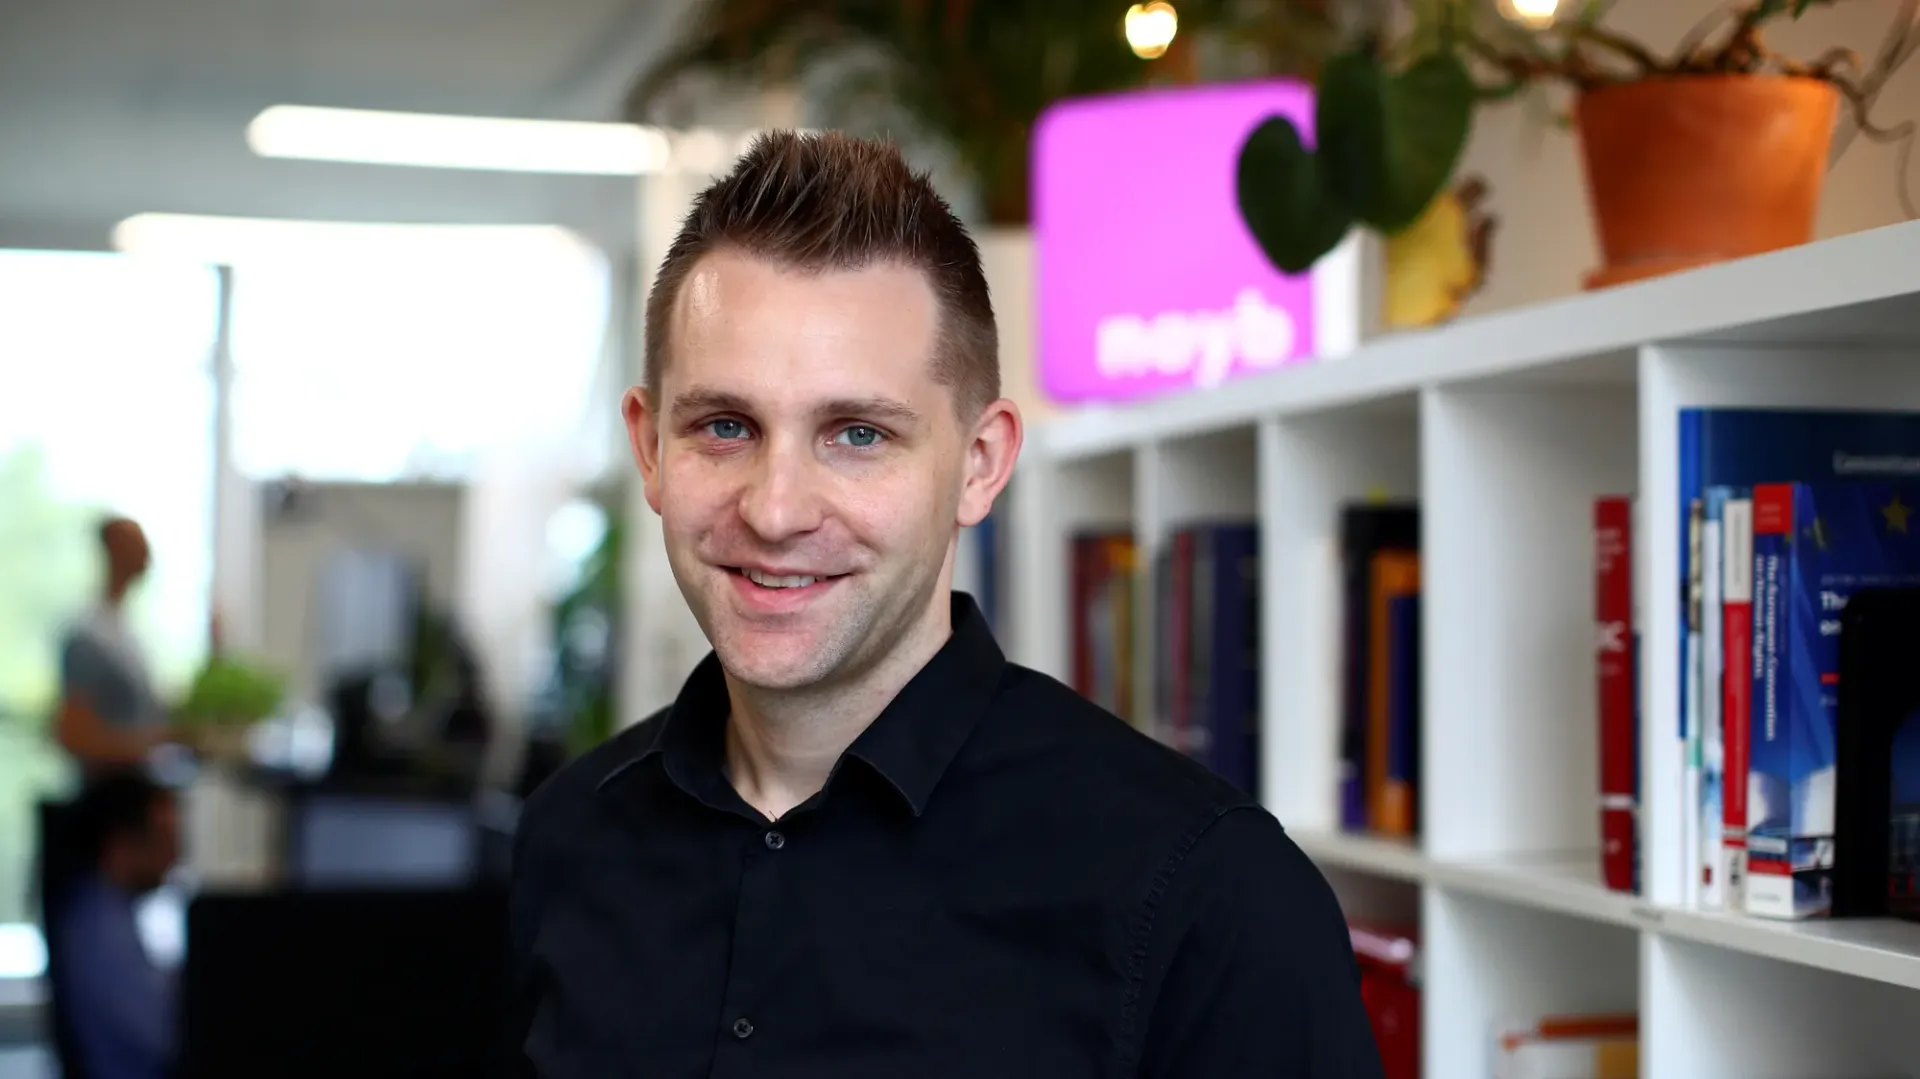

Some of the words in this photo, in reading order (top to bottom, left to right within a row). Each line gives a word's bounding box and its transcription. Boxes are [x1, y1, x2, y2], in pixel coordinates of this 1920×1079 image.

[1096, 289, 1294, 387] noyb
[1765, 583, 1779, 652] European
[1766, 657, 1779, 741] Convention
